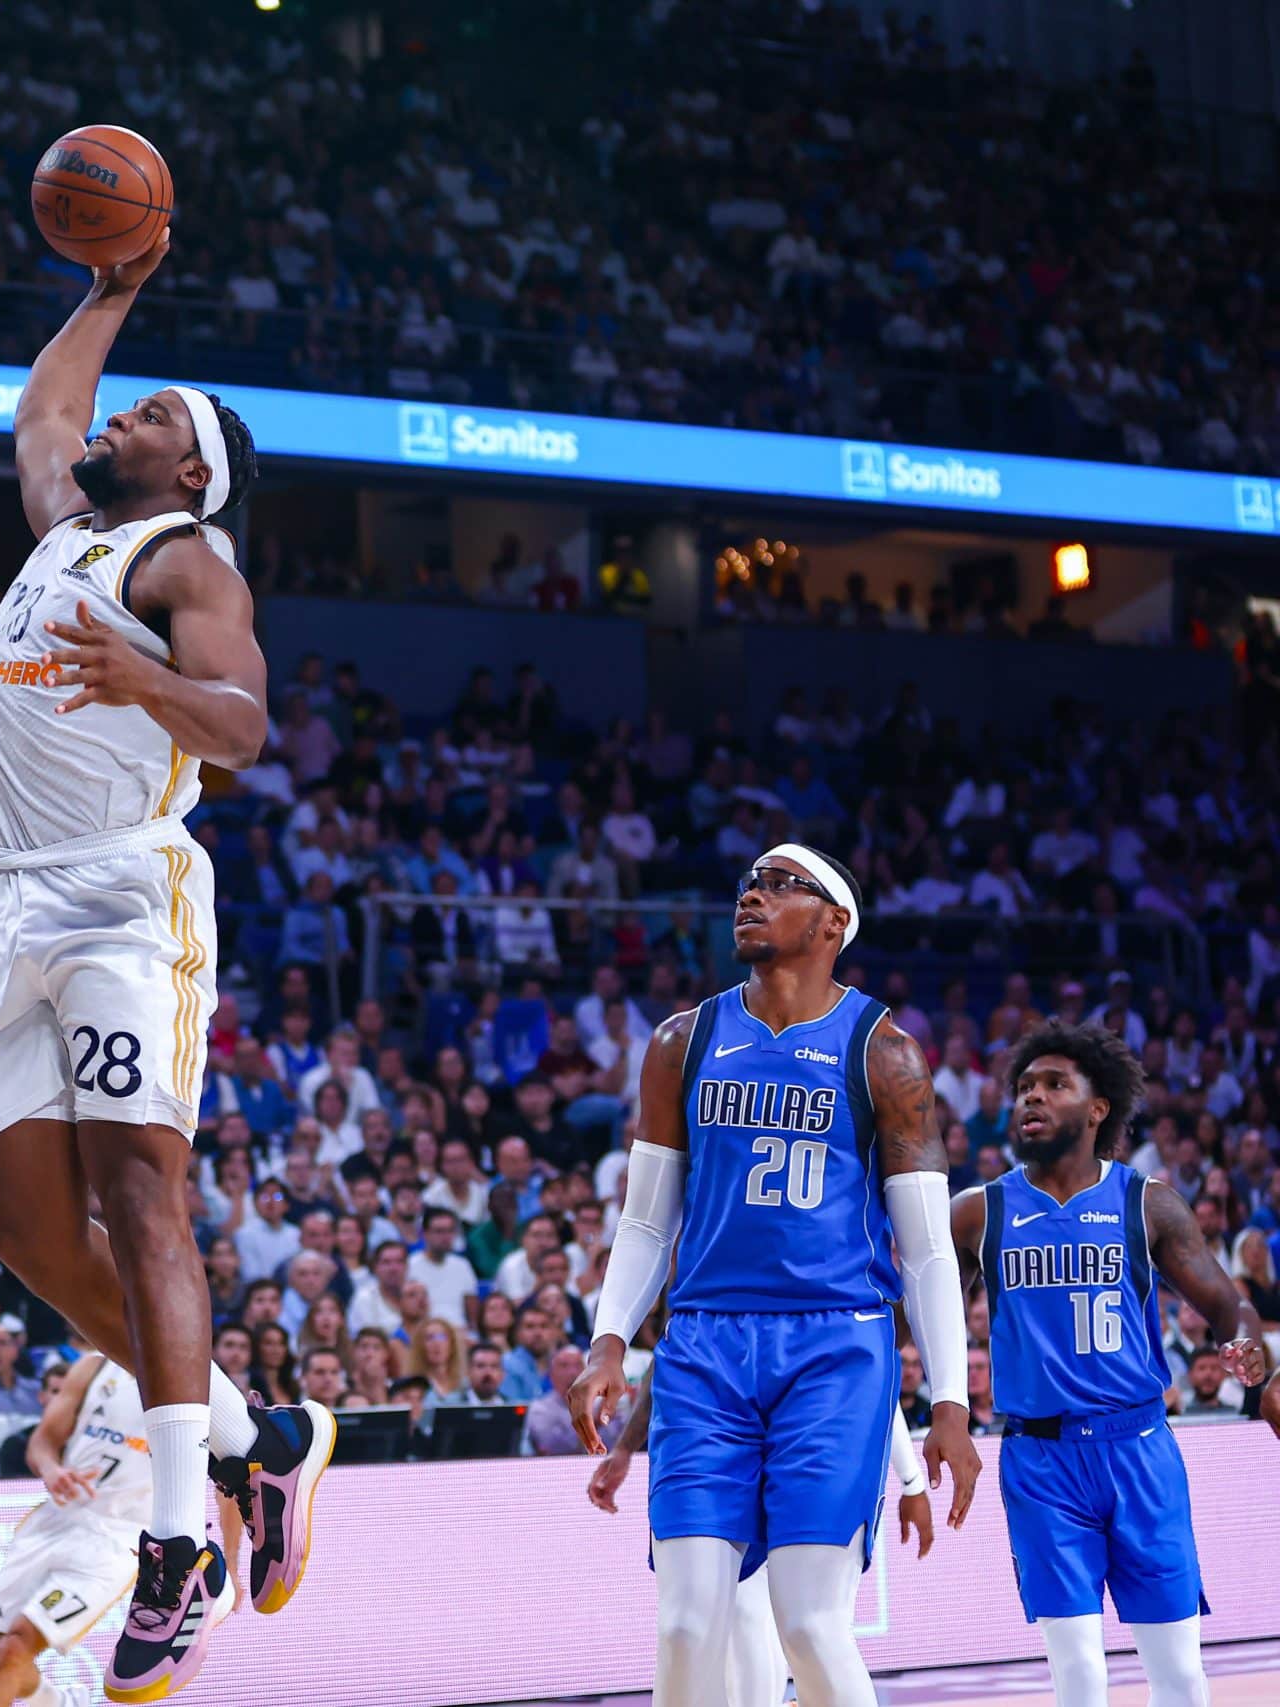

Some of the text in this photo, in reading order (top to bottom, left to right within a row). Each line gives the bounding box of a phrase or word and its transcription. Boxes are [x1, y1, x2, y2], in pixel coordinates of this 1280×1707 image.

[452, 414, 579, 463] Sanitas
[888, 453, 1001, 499] Sanitas
[73, 1025, 142, 1098] 28
[794, 1047, 839, 1065] chime
[698, 1079, 836, 1134] DALLAS
[745, 1136, 828, 1210] 20
[1079, 1211, 1120, 1224] chime
[1002, 1243, 1123, 1291] DALLAS
[1069, 1290, 1122, 1355] 16
[96, 1454, 121, 1488] 7
[55, 1594, 87, 1624] 7
